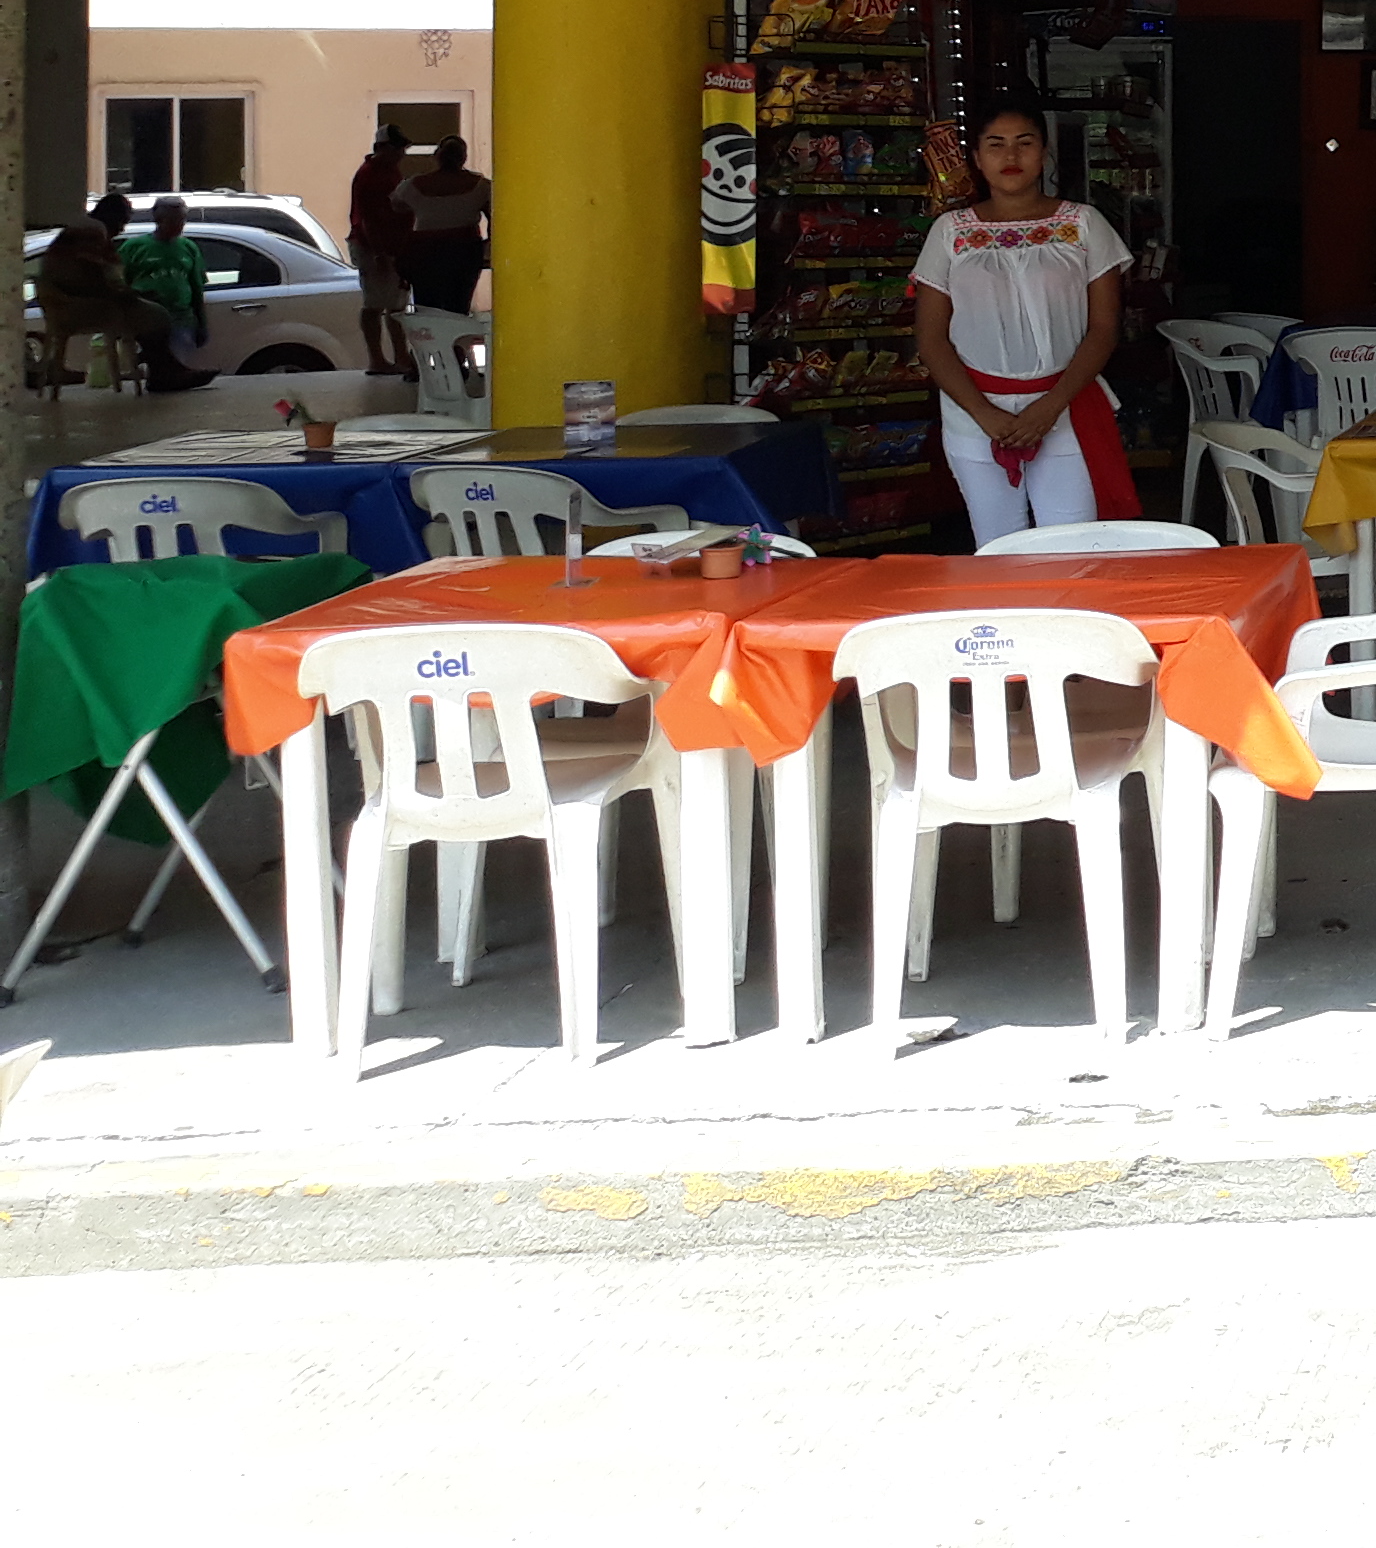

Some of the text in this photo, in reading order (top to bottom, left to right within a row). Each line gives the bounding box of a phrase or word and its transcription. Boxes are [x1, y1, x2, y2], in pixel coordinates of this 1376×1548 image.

[705, 70, 754, 90] Sabritas
[465, 481, 494, 502] ciel
[140, 494, 179, 515] ciel
[954, 636, 1015, 656] Corona
[417, 650, 470, 678] ciel
